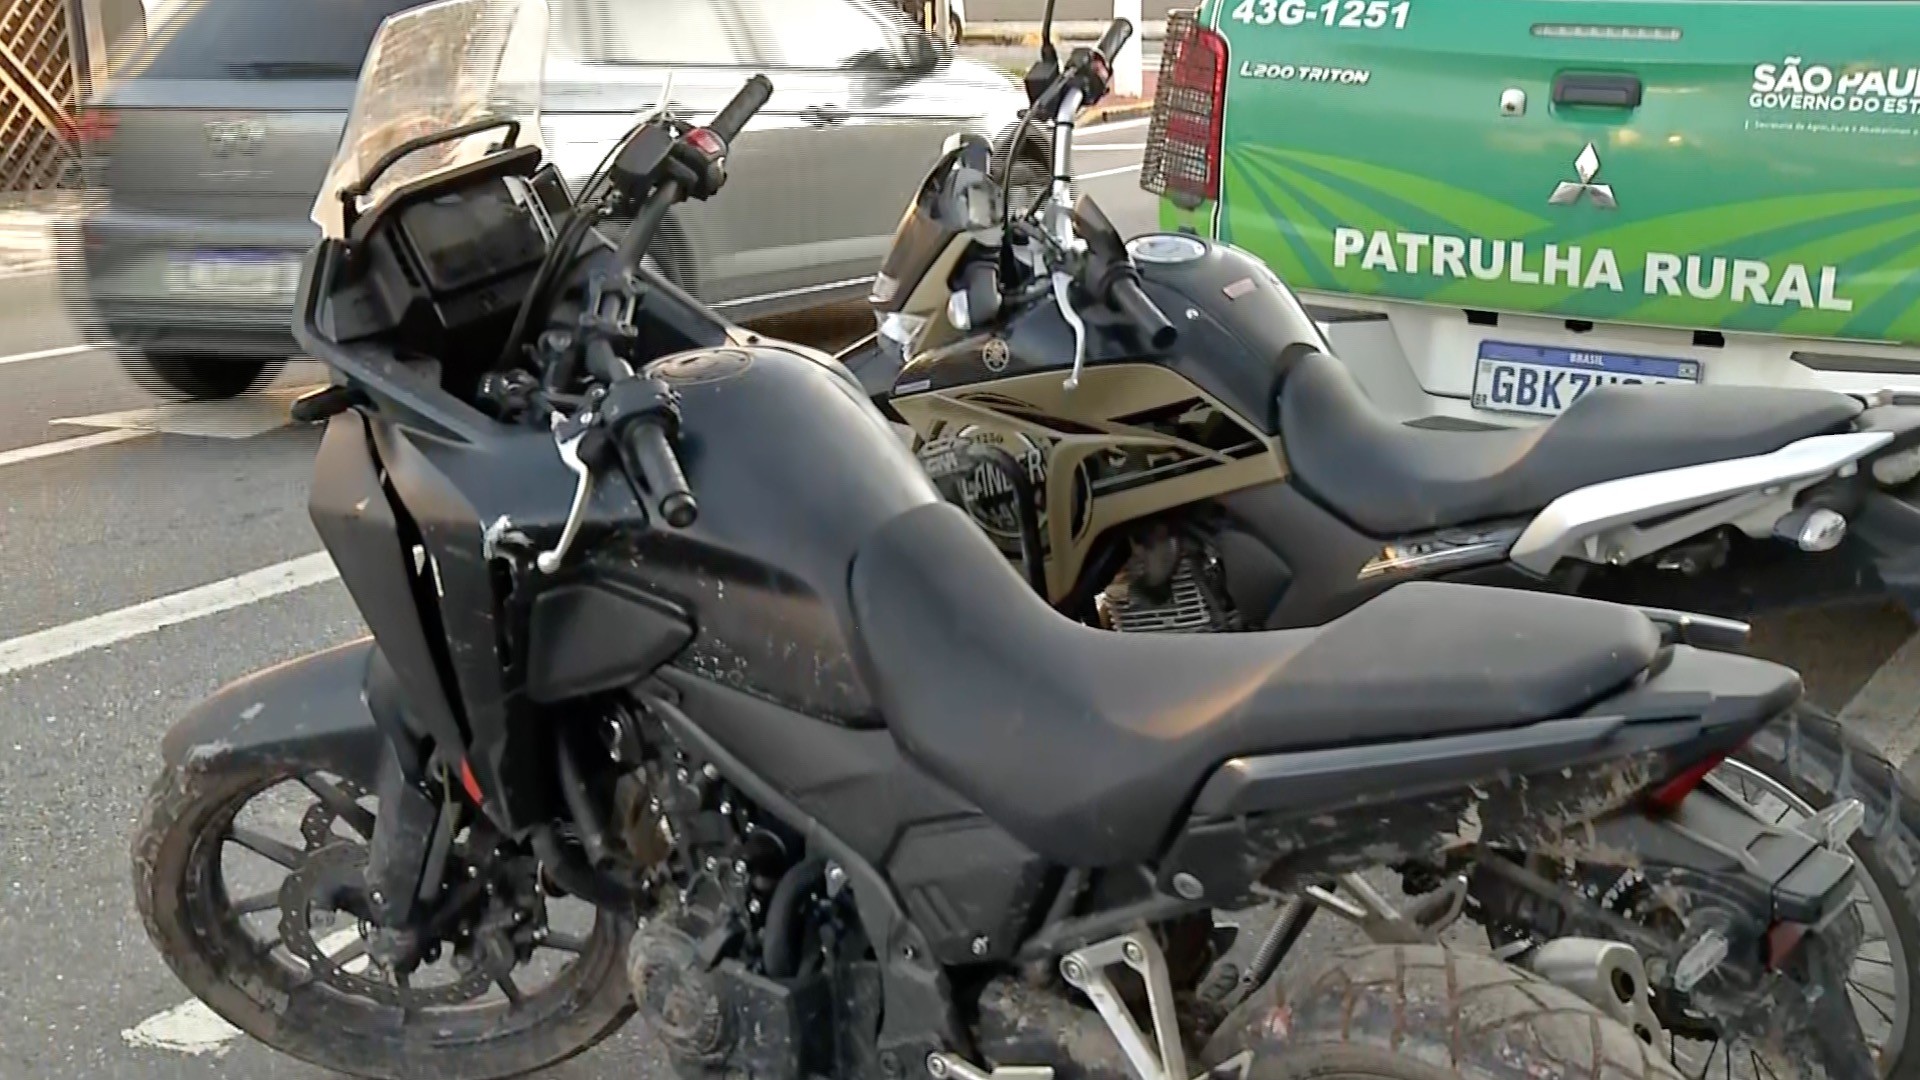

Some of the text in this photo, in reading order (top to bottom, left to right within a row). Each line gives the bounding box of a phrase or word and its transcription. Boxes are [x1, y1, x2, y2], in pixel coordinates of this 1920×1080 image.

[1232, 0, 1410, 29] 43G-1251
[1240, 60, 1370, 85] L200 TRITON
[1752, 56, 1920, 98] SÃO PAU
[1749, 92, 1920, 115] GOVERNO DO EST
[1334, 227, 1853, 312] PATRULHA RURAL
[1569, 352, 1604, 367] BRASIL
[1491, 364, 1667, 410] GBK7
